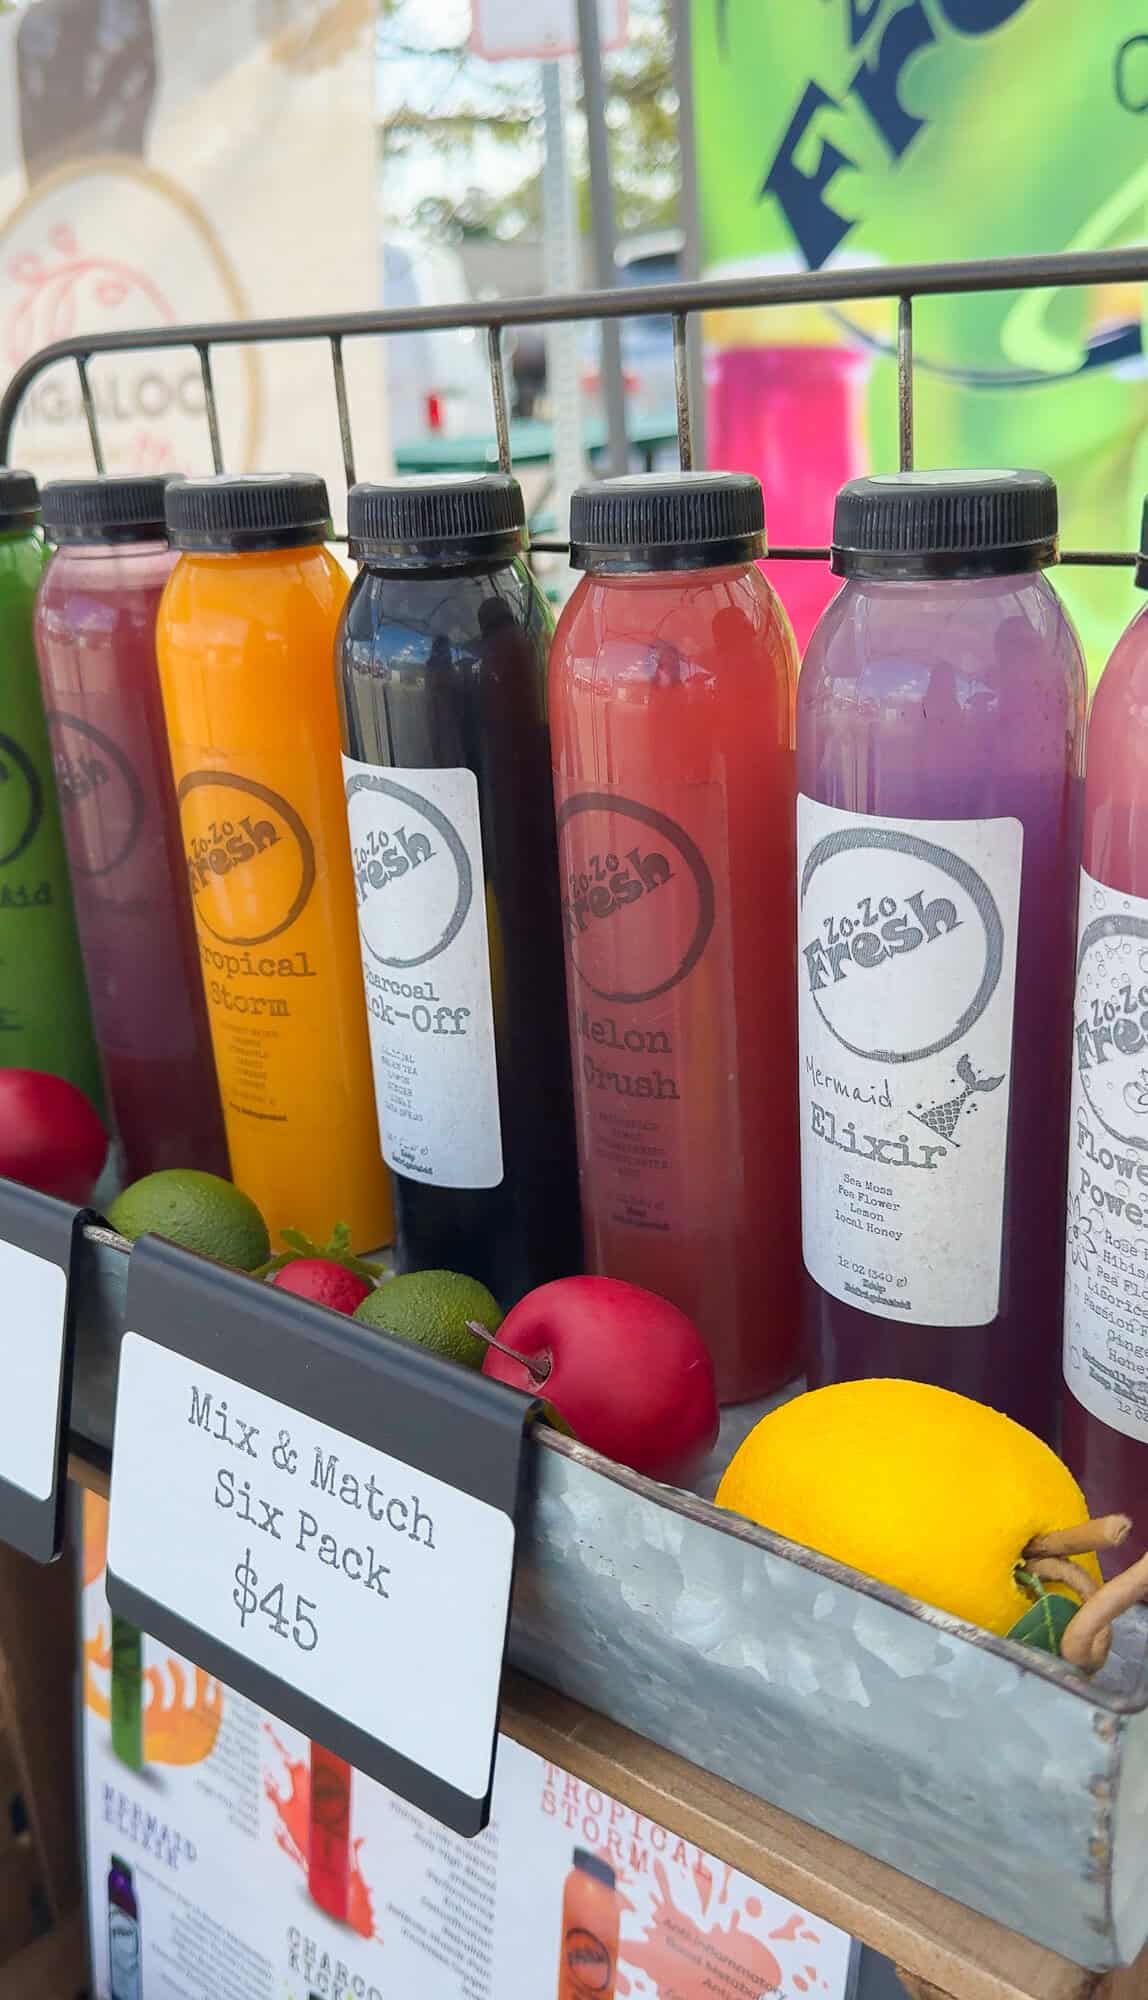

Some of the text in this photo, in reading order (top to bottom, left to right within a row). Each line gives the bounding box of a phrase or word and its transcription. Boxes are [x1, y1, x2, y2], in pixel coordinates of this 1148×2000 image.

[357, 826, 438, 903] resh
[202, 944, 318, 980] ropical
[801, 889, 965, 992] Fresh
[368, 994, 471, 1036] ck-Off
[1075, 1008, 1148, 1071] Fre
[805, 1054, 893, 1110] Mermaid
[810, 1100, 948, 1169] Elixir
[843, 1173, 894, 1197] Sea Moss
[850, 1203, 885, 1223] Lemon
[858, 1192, 902, 1212] Flower
[1080, 1166, 1148, 1225] Powe
[866, 1222, 904, 1241] Honey
[1103, 1249, 1148, 1281] Hibis
[1108, 1348, 1148, 1380] Hone
[188, 1385, 436, 1550] Mix & Match
[214, 1468, 392, 1599] Six Pack
[232, 1547, 319, 1652] $45
[541, 1789, 649, 1875] STORM
